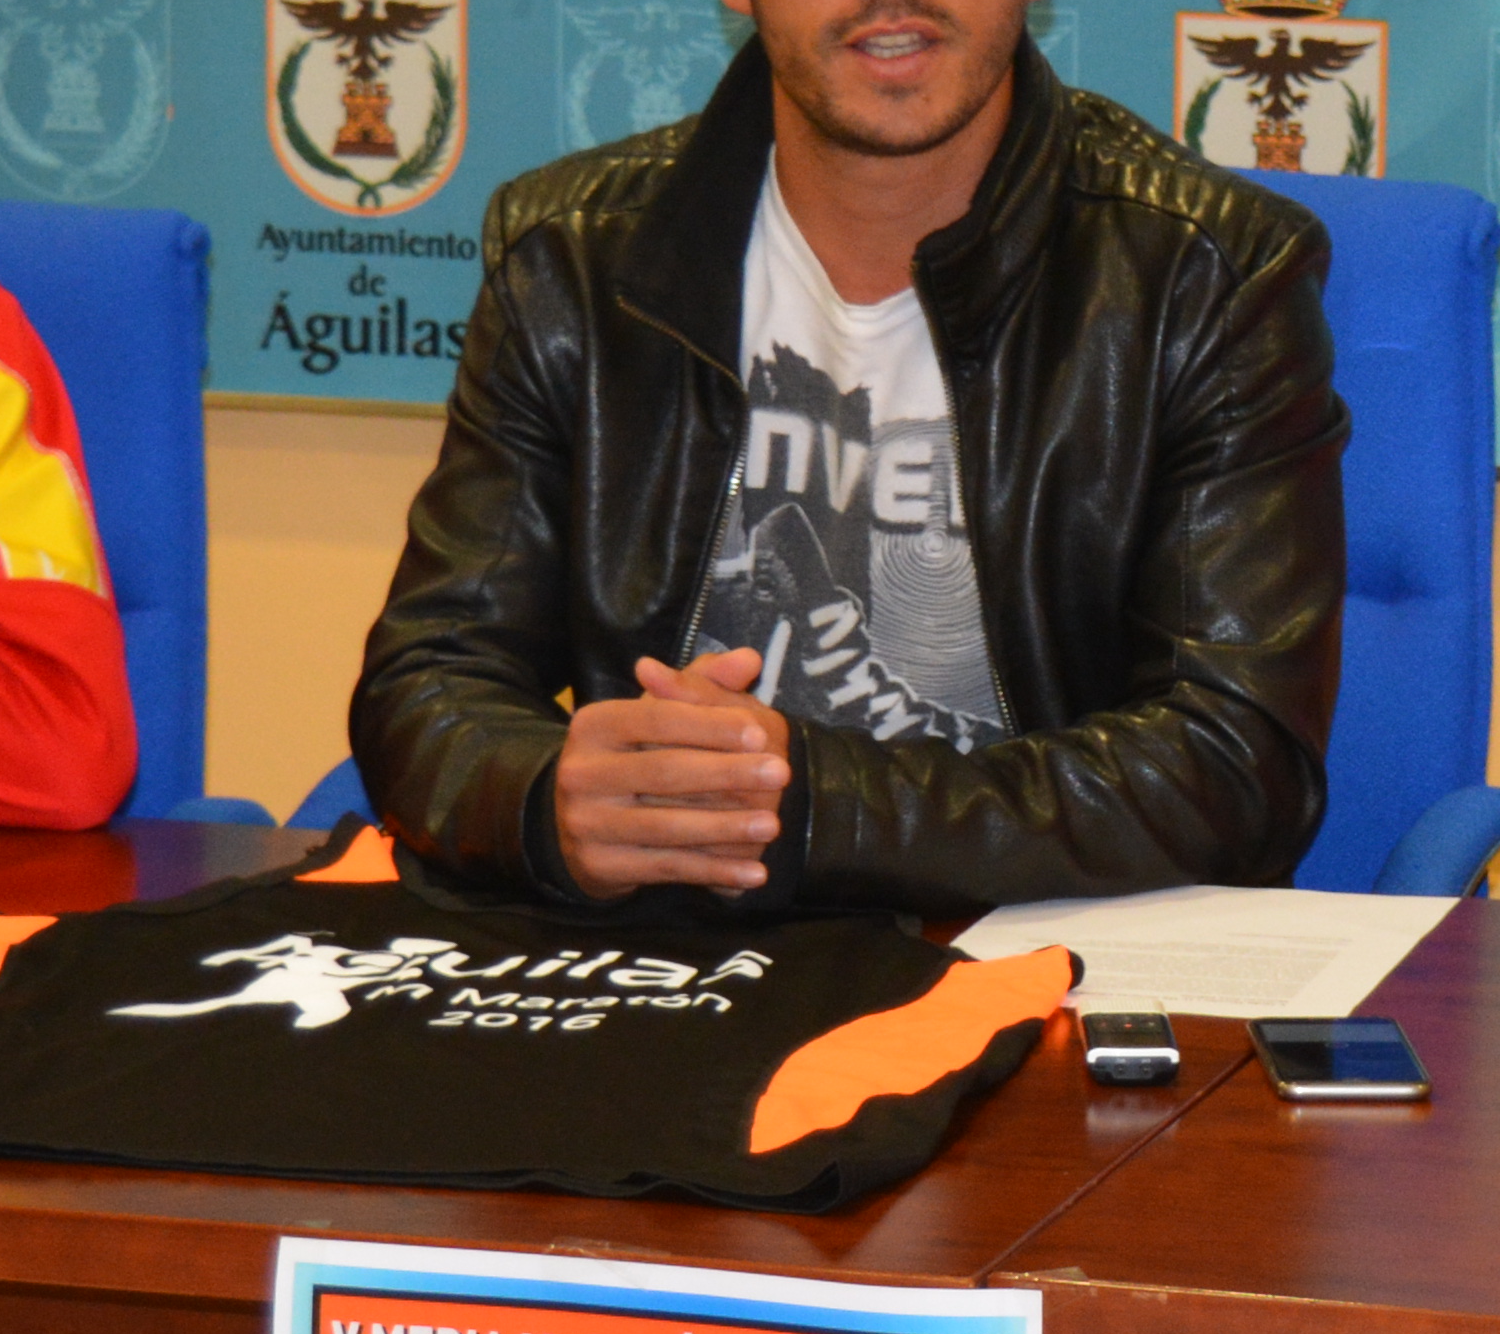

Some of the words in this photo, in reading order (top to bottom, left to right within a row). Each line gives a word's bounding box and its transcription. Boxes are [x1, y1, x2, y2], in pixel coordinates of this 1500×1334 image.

[257, 222, 476, 263] Ayuntamiento
[348, 266, 387, 297] de
[261, 293, 467, 374] Águilas
[428, 1010, 608, 1032] 2016
